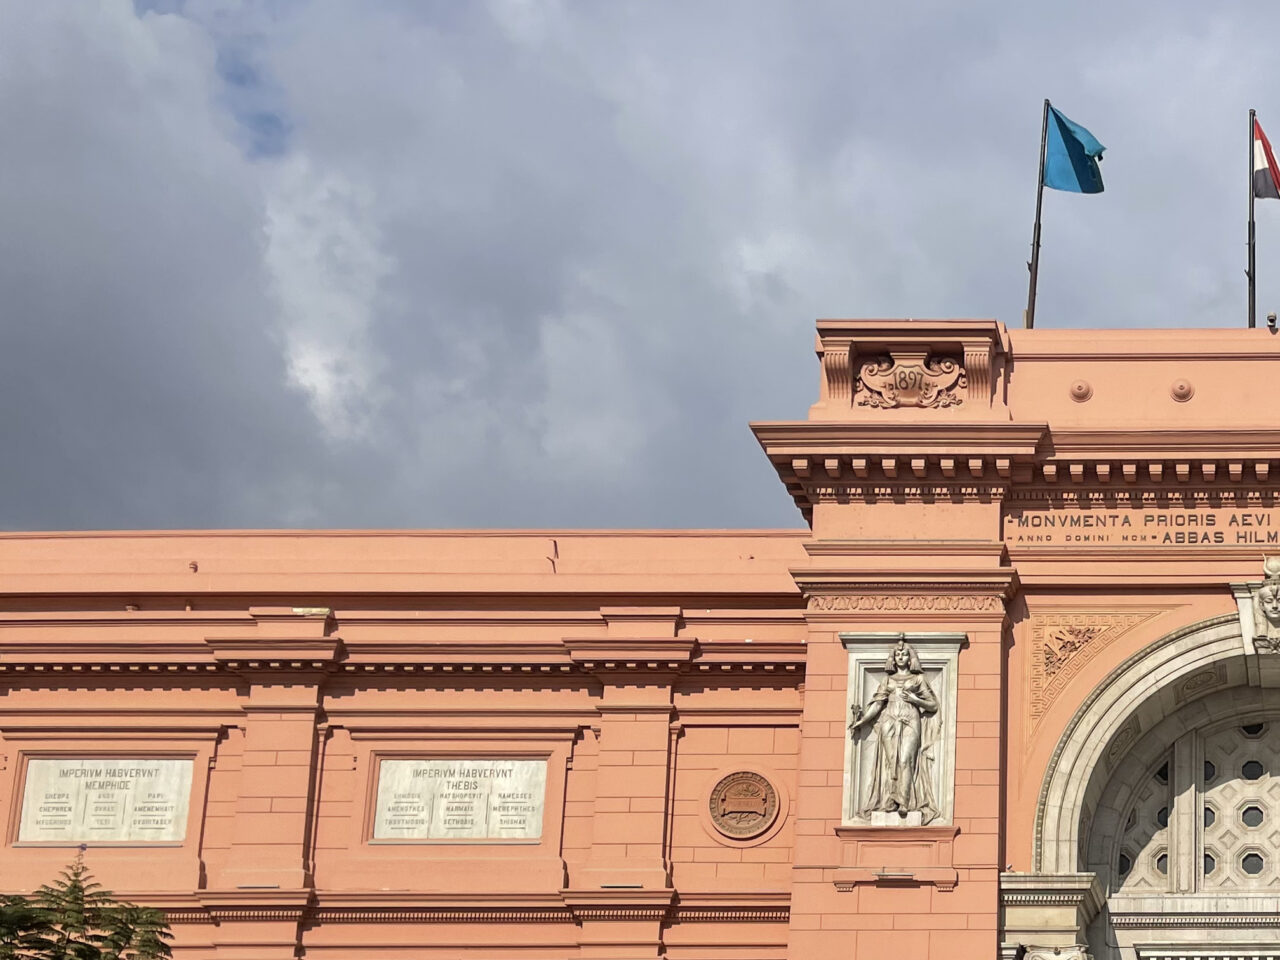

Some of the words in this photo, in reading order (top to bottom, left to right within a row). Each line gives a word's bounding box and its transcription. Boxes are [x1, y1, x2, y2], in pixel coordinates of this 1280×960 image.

[893, 370, 924, 390] 1897
[1018, 514, 1132, 528] MONVMENTA
[1144, 514, 1216, 527] PRIORIS
[1228, 514, 1271, 526] AEVI
[1162, 531, 1224, 544] ABBAS
[58, 768, 102, 778] IMPERIVM
[105, 768, 160, 778] HABVERVNT
[412, 769, 455, 778] IMPERIVM
[459, 769, 514, 778] HABVERVNT
[85, 780, 131, 790] MEMPHIDE
[446, 781, 479, 790] THEBIS
